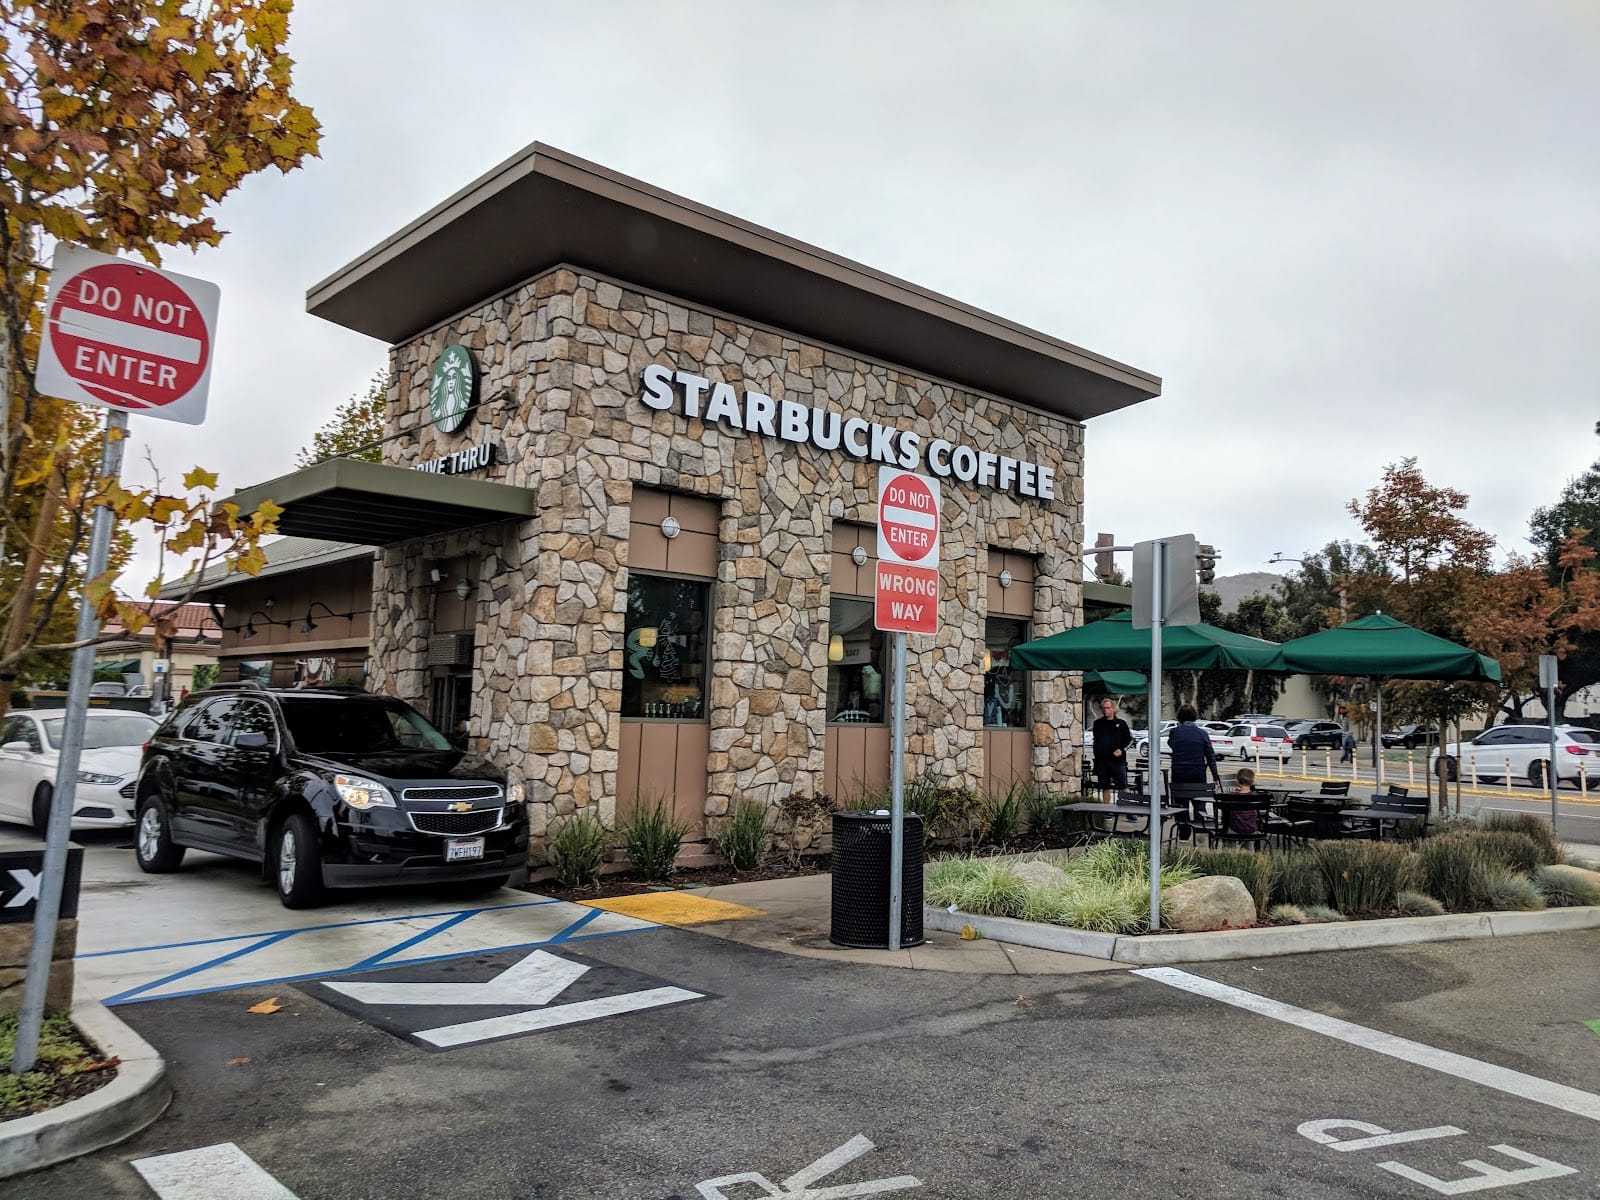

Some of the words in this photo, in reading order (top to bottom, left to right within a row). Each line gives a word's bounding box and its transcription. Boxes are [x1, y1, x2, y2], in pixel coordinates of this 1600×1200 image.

[79, 279, 122, 312] DO
[133, 294, 192, 328] NOT
[75, 345, 177, 390] ENTER
[641, 363, 921, 470] STARBUCKS
[928, 438, 1055, 501] COFFEE
[449, 442, 492, 474] THRU
[889, 486, 906, 504] DO
[909, 491, 931, 510] NOT
[890, 527, 928, 548] ENTER
[879, 572, 936, 597] WRONG
[891, 602, 924, 622] WAY
